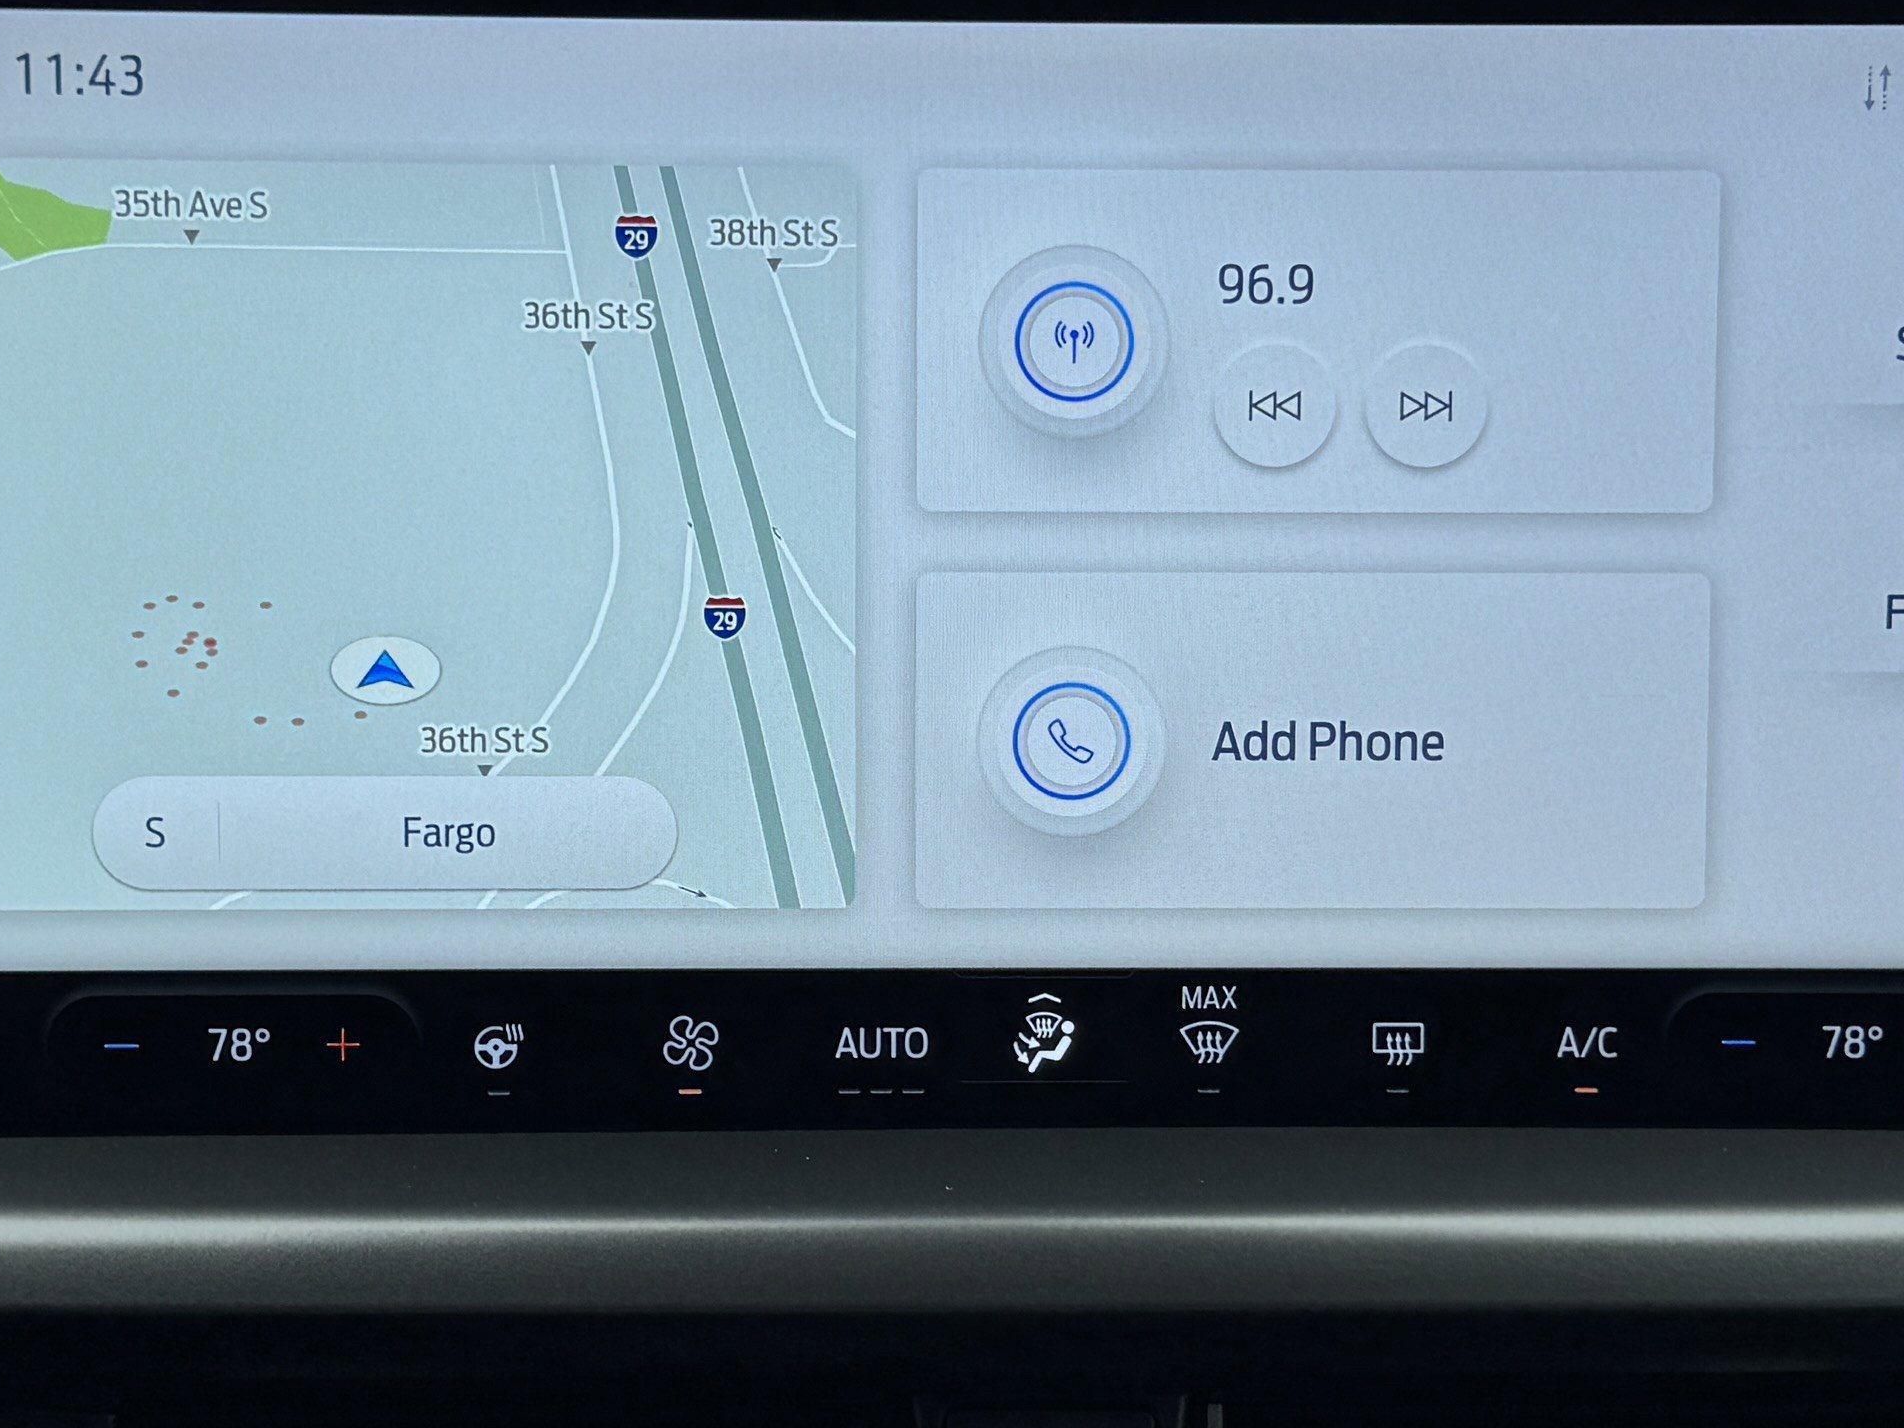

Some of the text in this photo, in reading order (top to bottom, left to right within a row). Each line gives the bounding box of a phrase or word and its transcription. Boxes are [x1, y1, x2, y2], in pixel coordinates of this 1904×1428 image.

[15, 52, 144, 96] 11:43
[115, 189, 268, 219] 35th Ave S
[623, 229, 649, 250] 29
[710, 218, 838, 247] 38th St S
[1218, 263, 1314, 305] 96.9
[524, 301, 653, 330] 36th St S
[712, 611, 738, 631] 29
[421, 726, 549, 754] 36th St S
[1211, 719, 1445, 762] Add Phone
[145, 816, 496, 854] S Fargo
[1181, 985, 1237, 1010] MAX
[835, 1026, 929, 1059] AUTO
[1556, 1026, 1618, 1059] A/C
